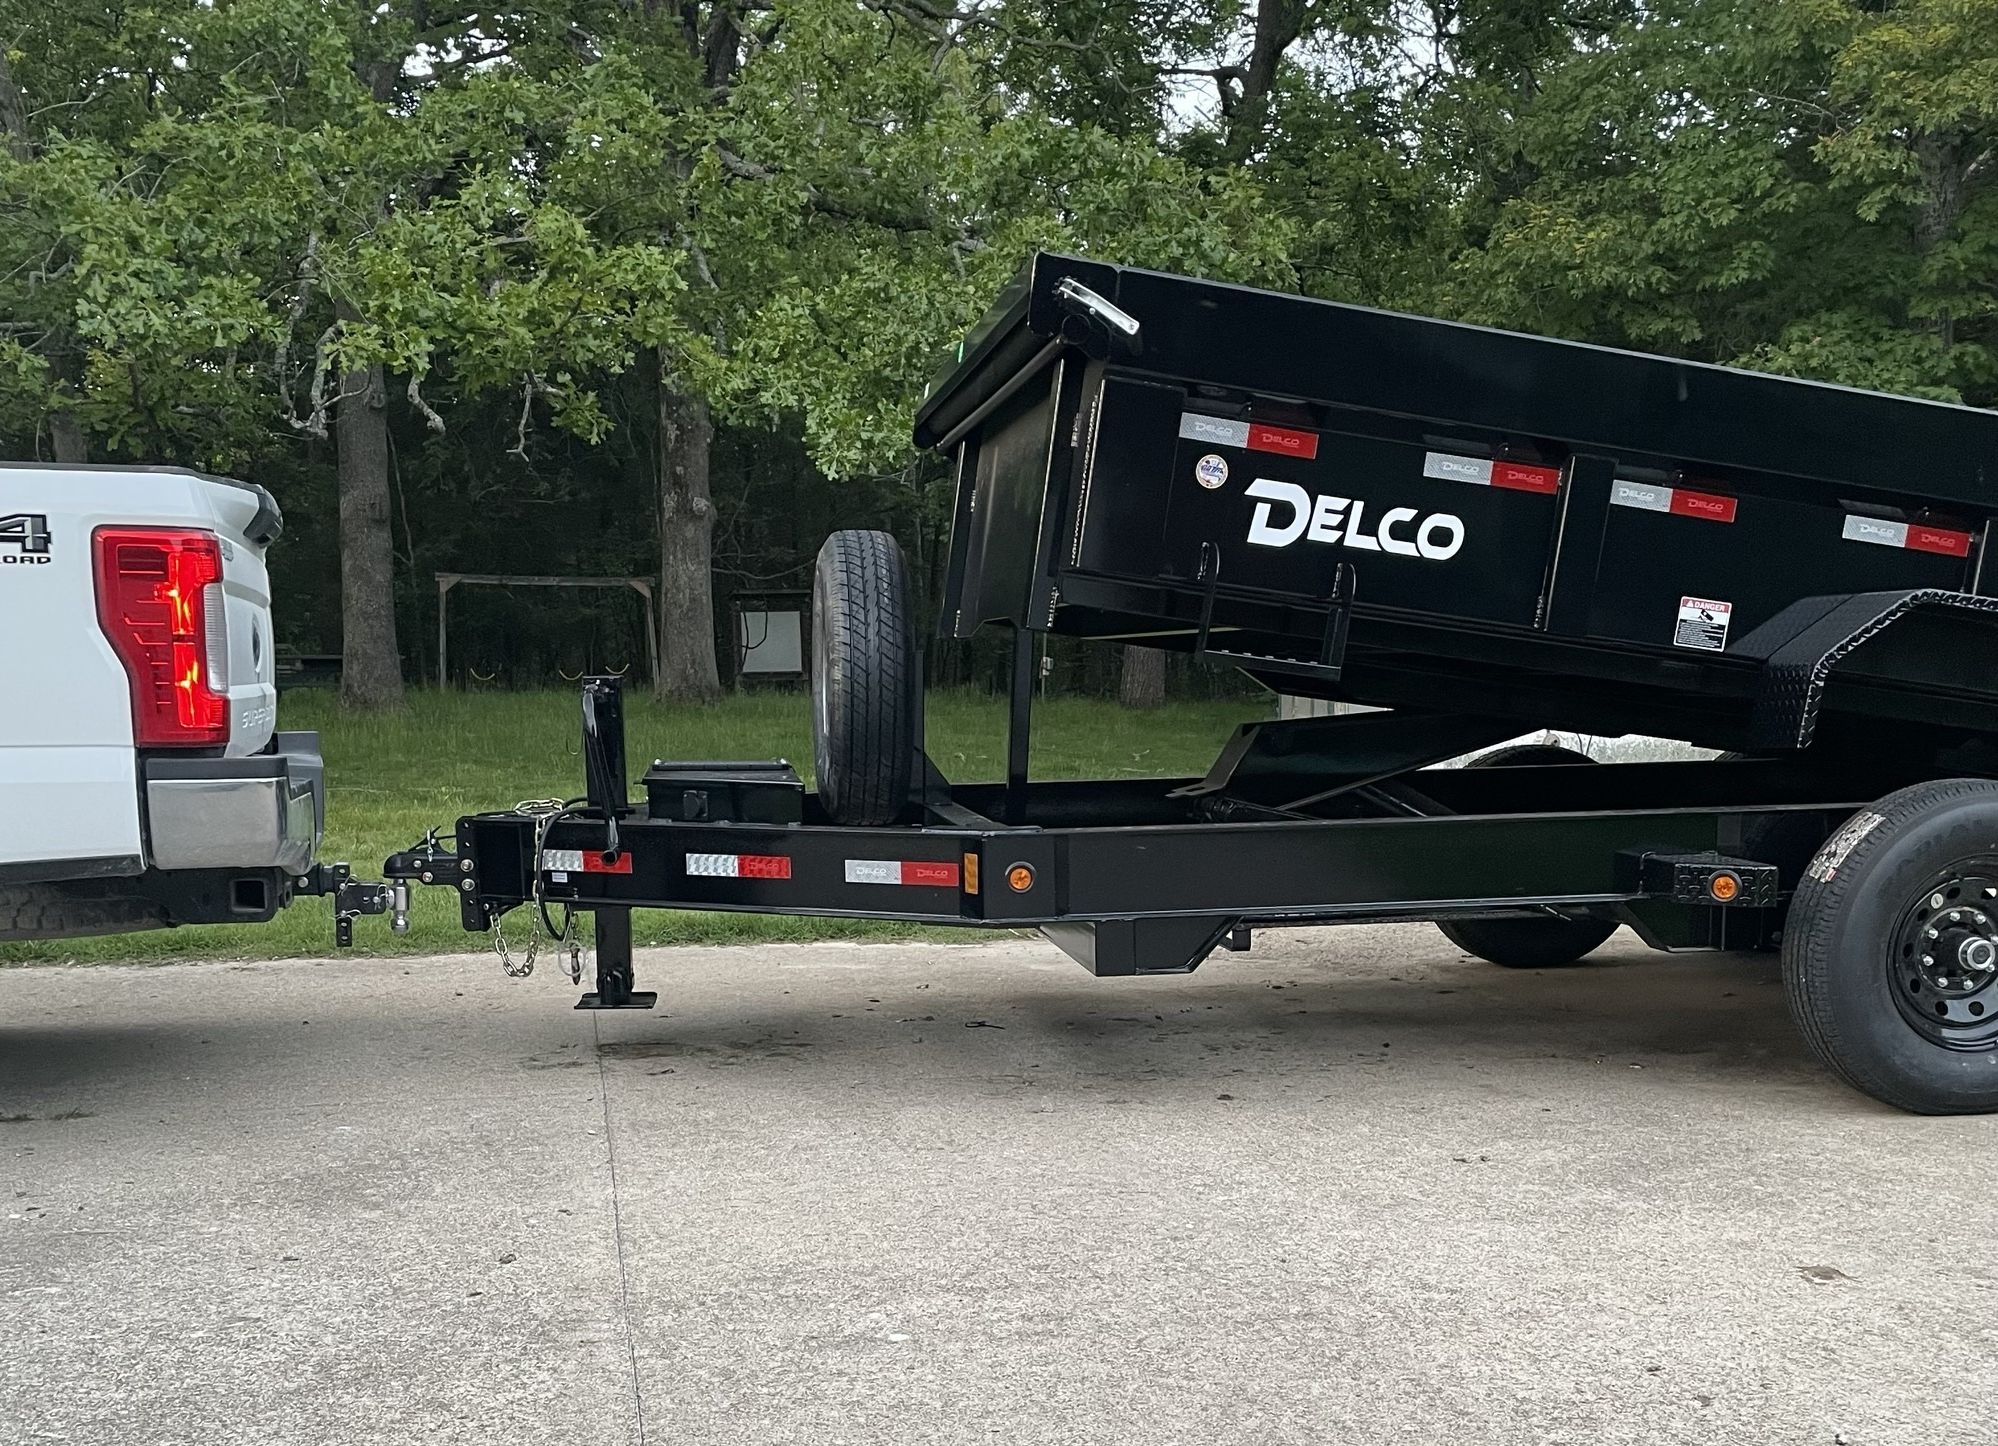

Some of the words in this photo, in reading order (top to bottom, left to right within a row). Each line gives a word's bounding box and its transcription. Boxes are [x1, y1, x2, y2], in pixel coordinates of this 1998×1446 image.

[1262, 433, 1300, 445] DELCO
[1507, 470, 1544, 482] DELCO
[1687, 498, 1724, 510] DELCO
[1244, 478, 1465, 561] DELCO
[0, 555, 51, 564] OAD
[1694, 601, 1726, 612] DANGER
[916, 868, 949, 877] DELCO
